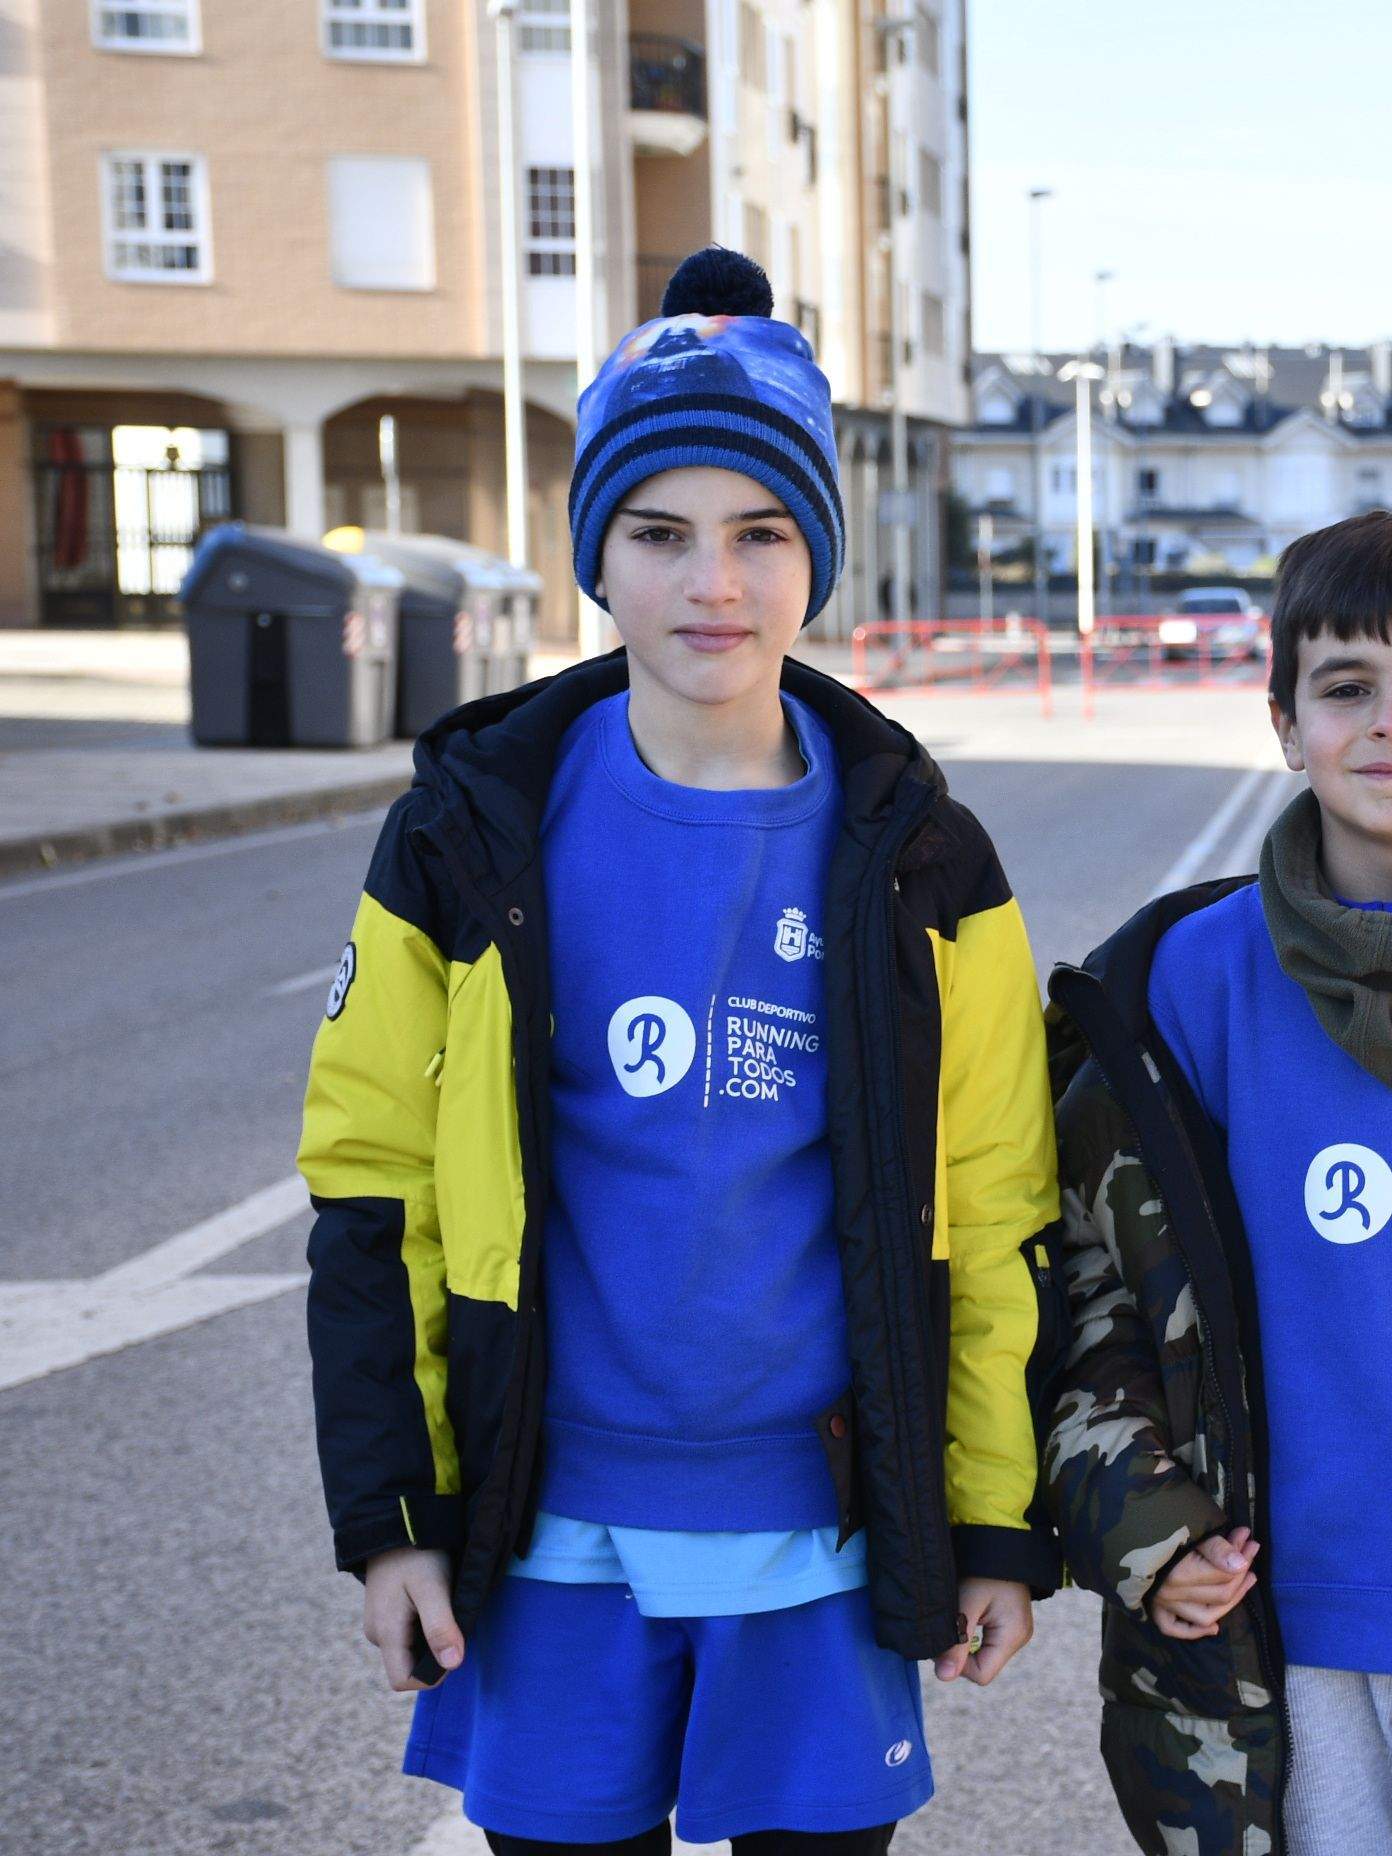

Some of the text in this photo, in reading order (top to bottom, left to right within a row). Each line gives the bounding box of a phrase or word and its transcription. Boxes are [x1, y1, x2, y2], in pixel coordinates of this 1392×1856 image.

[727, 996, 816, 1024] CLUB DEPORTIVO
[727, 1016, 820, 1053] RUNNING
[727, 1037, 777, 1064] PARA
[728, 1056, 797, 1087] TODOS
[719, 1078, 779, 1102] .COM
